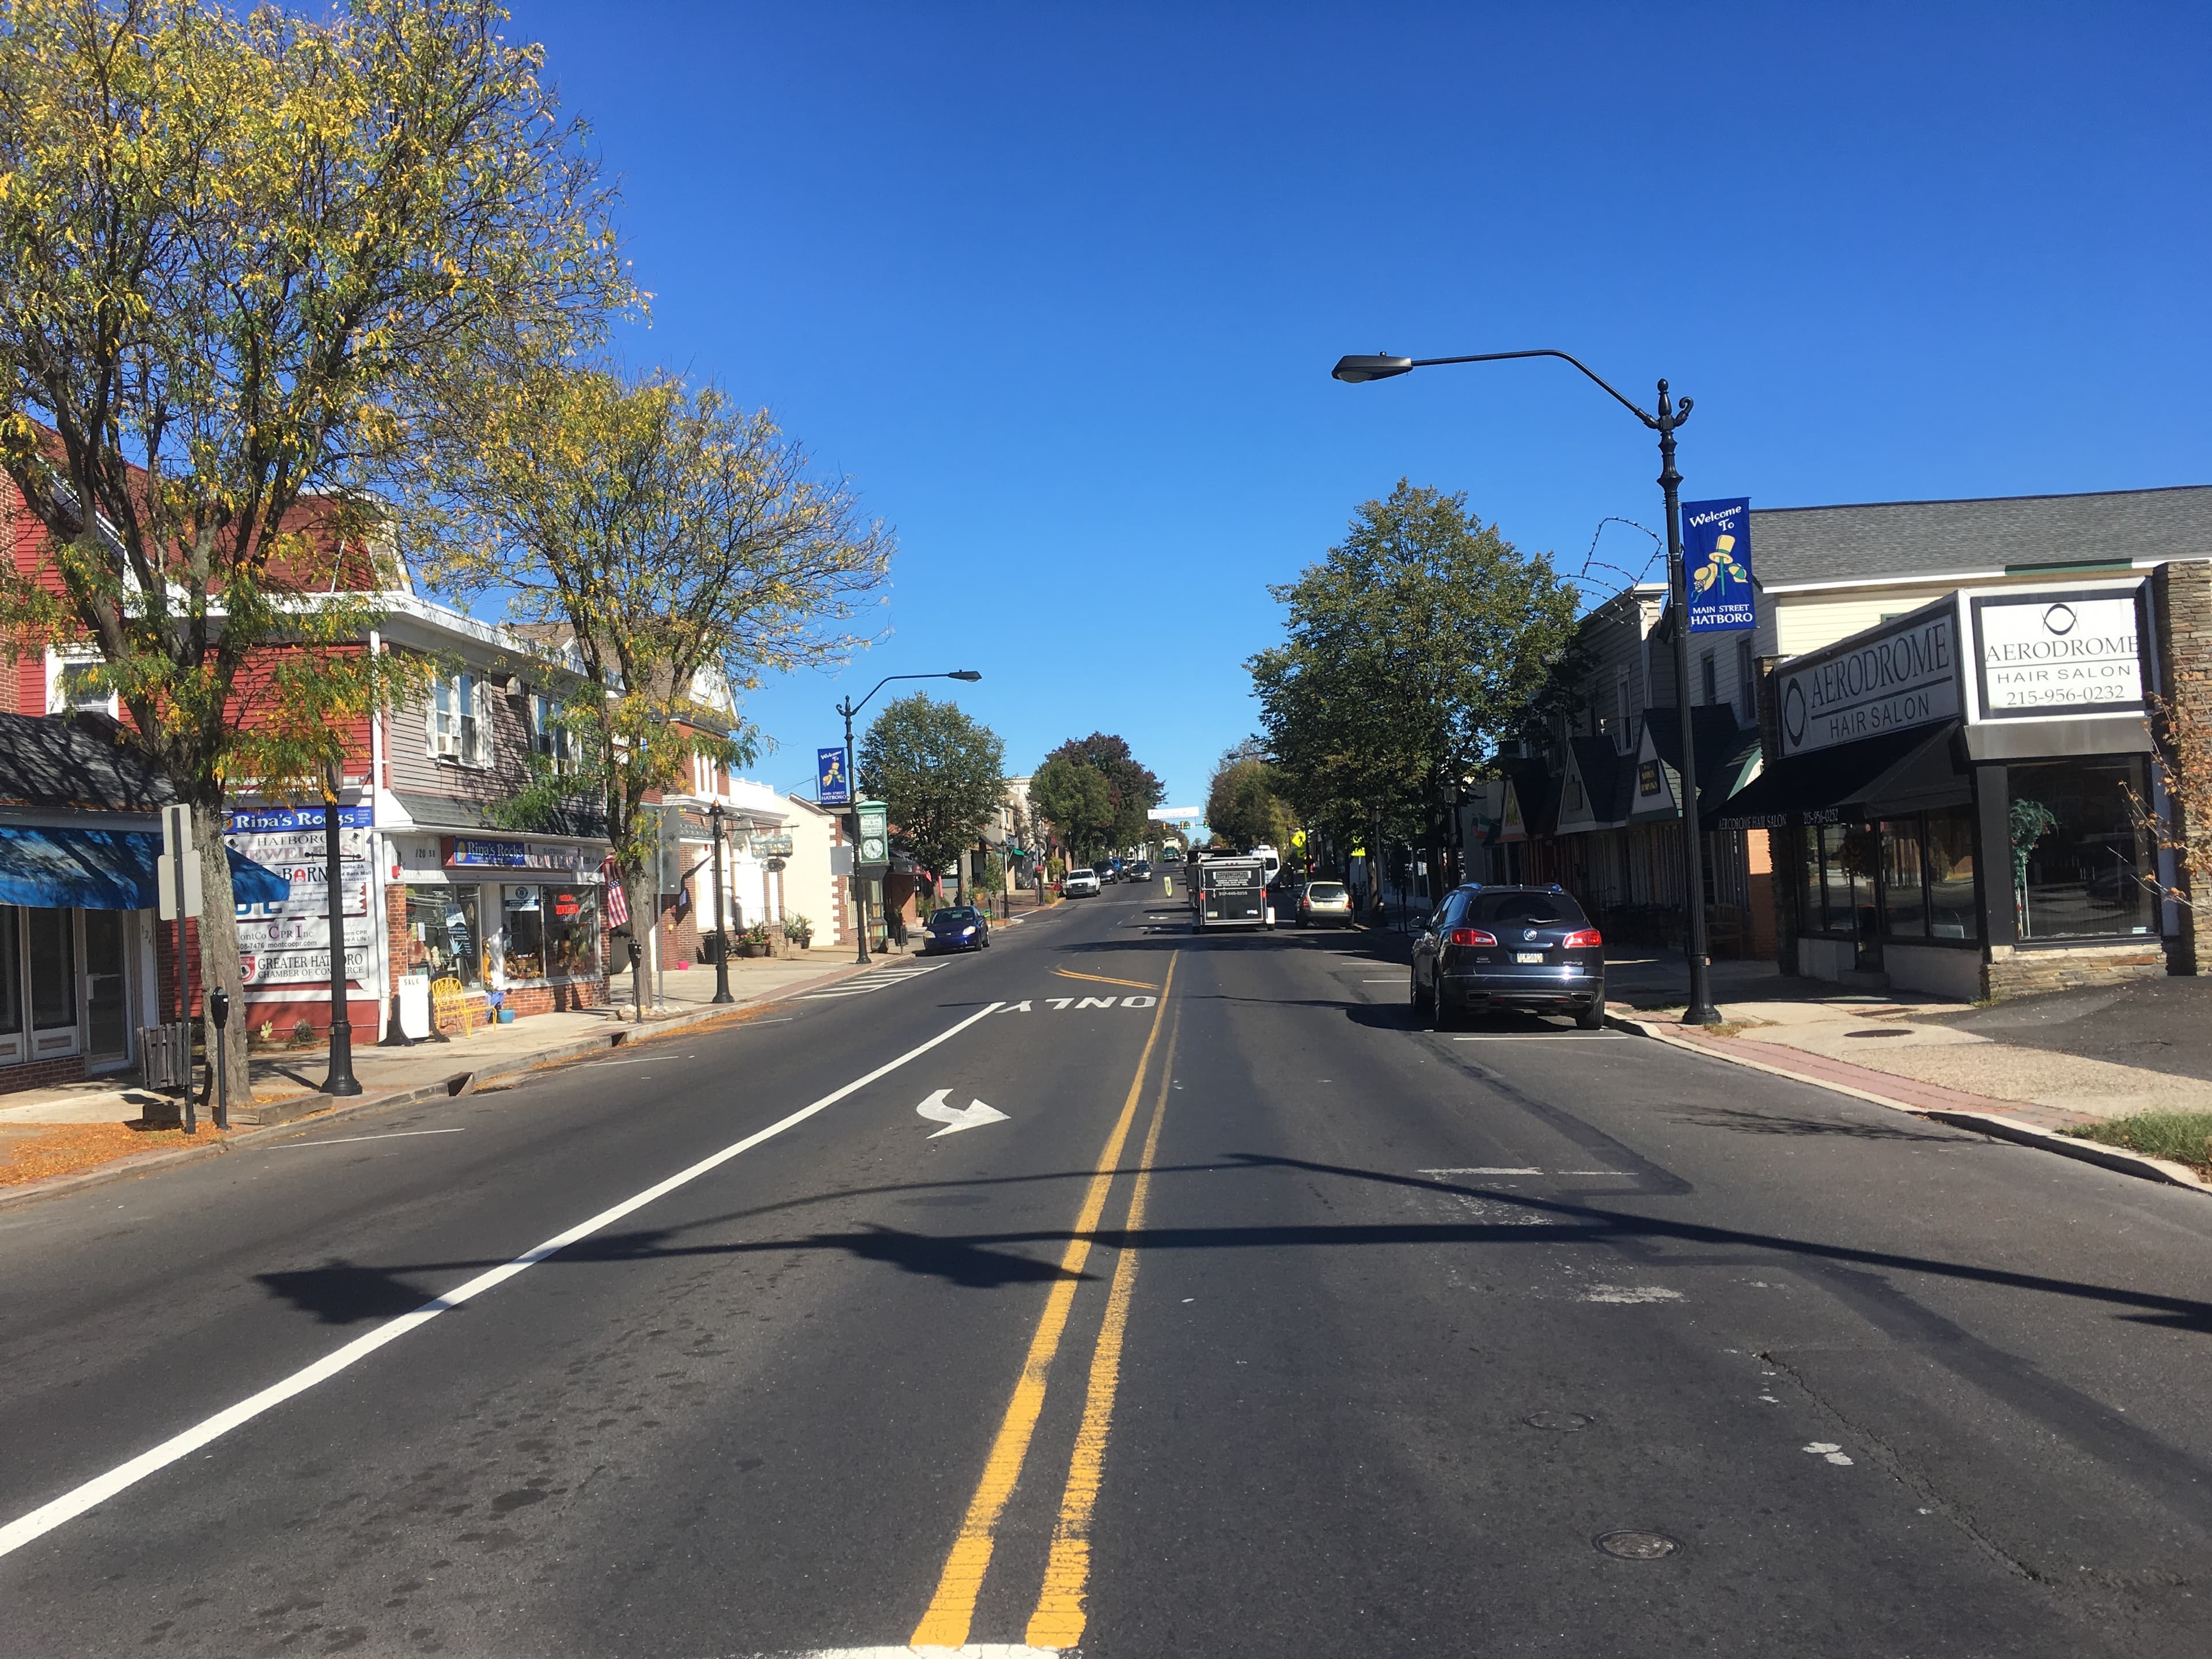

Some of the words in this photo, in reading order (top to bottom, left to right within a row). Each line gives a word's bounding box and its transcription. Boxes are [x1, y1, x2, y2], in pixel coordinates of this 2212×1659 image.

[1689, 506, 1742, 528] Welcome
[1718, 518, 1734, 531] To
[1692, 606, 1715, 615] MAIN
[1719, 604, 1750, 613] STREET
[1691, 612, 1753, 626] HATBORO
[1986, 635, 2140, 662] AERODROME
[1810, 622, 1950, 709] AERODROME
[1997, 670, 2048, 684] HAIR
[2057, 665, 2131, 681] SALON
[2006, 685, 2125, 706] 215-956-0232
[1830, 713, 1866, 739] HAIR
[1870, 693, 1930, 730] SALON
[820, 750, 842, 760] Welcome
[235, 813, 293, 828] Rina's
[1767, 813, 1786, 827] SALON
[415, 848, 426, 858] 120
[467, 842, 496, 857] Rina's
[497, 843, 523, 859] Rocks
[240, 931, 267, 941] ontCo
[268, 926, 293, 940] CPR
[296, 925, 313, 938] Inc
[268, 940, 317, 949] montcocpr.com
[257, 956, 308, 970] GREATER
[311, 953, 363, 968] HATRO
[257, 968, 299, 979] CHAMBER
[302, 968, 312, 976] OF
[995, 996, 1157, 1013] ONLY
